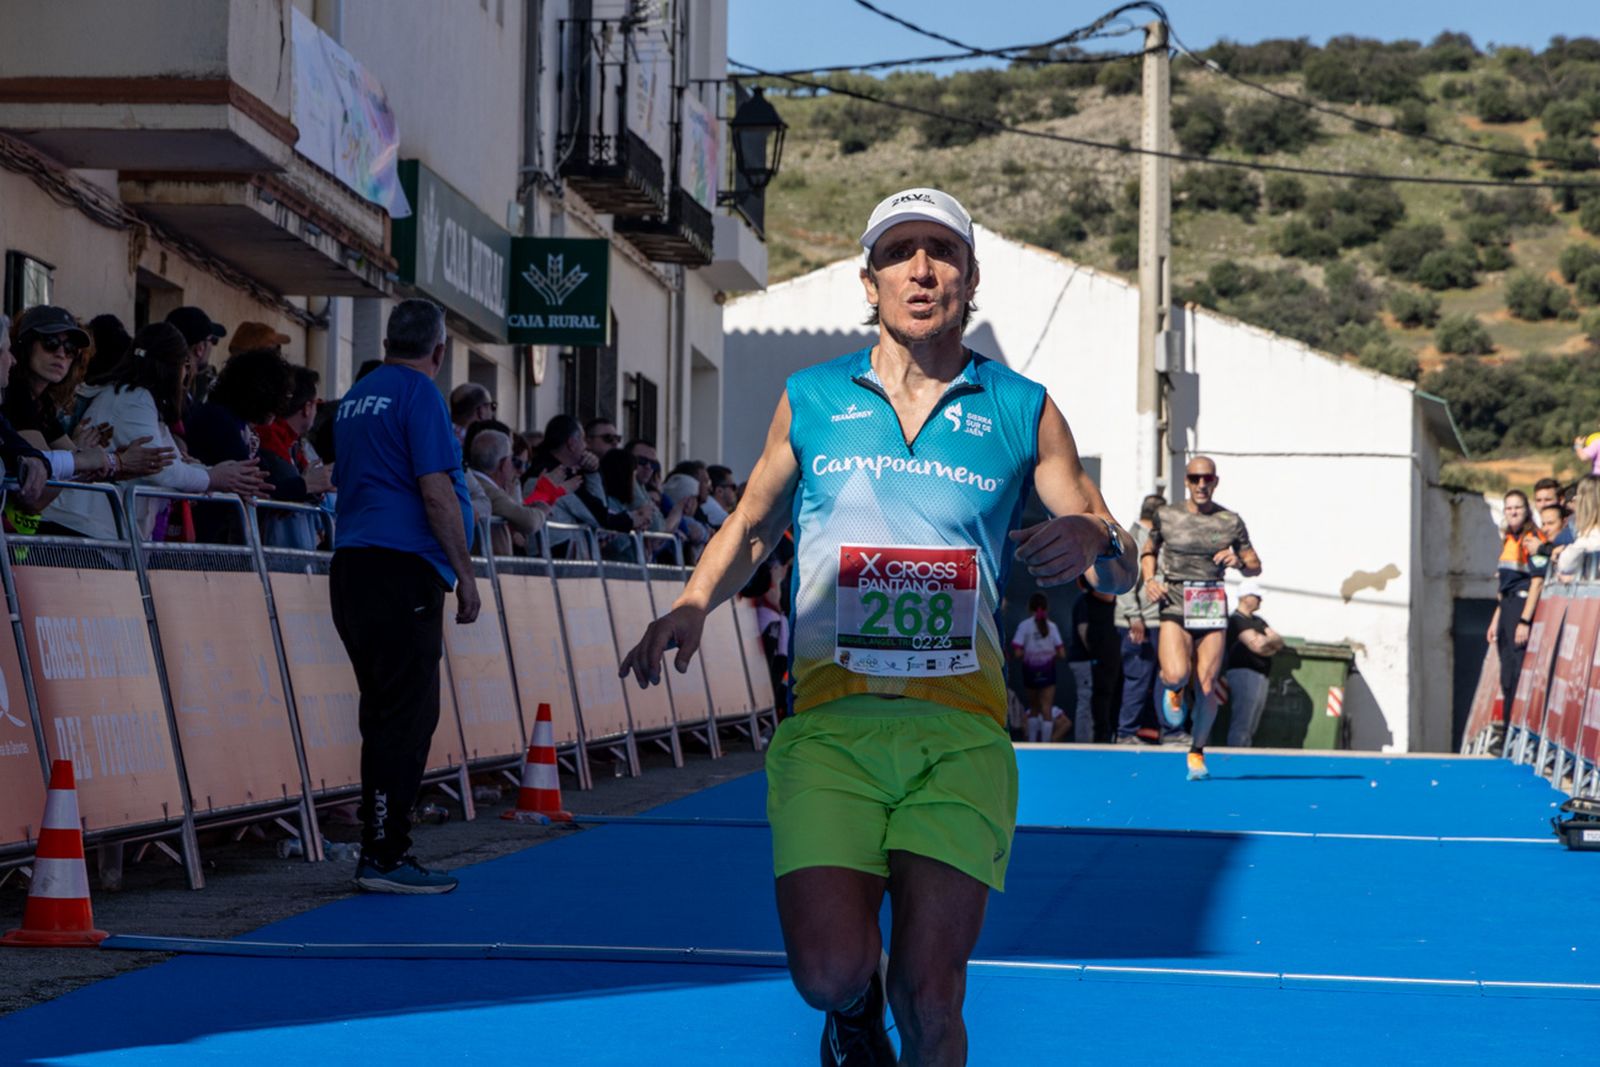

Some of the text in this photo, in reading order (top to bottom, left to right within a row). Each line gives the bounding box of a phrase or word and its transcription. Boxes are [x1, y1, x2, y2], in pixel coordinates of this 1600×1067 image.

[508, 315, 601, 328] CAJA RURAL
[812, 454, 997, 492] Campoameno
[859, 552, 882, 577] X
[885, 561, 958, 580] CROSS
[858, 578, 941, 595] PANTANO
[860, 591, 953, 636] 268
